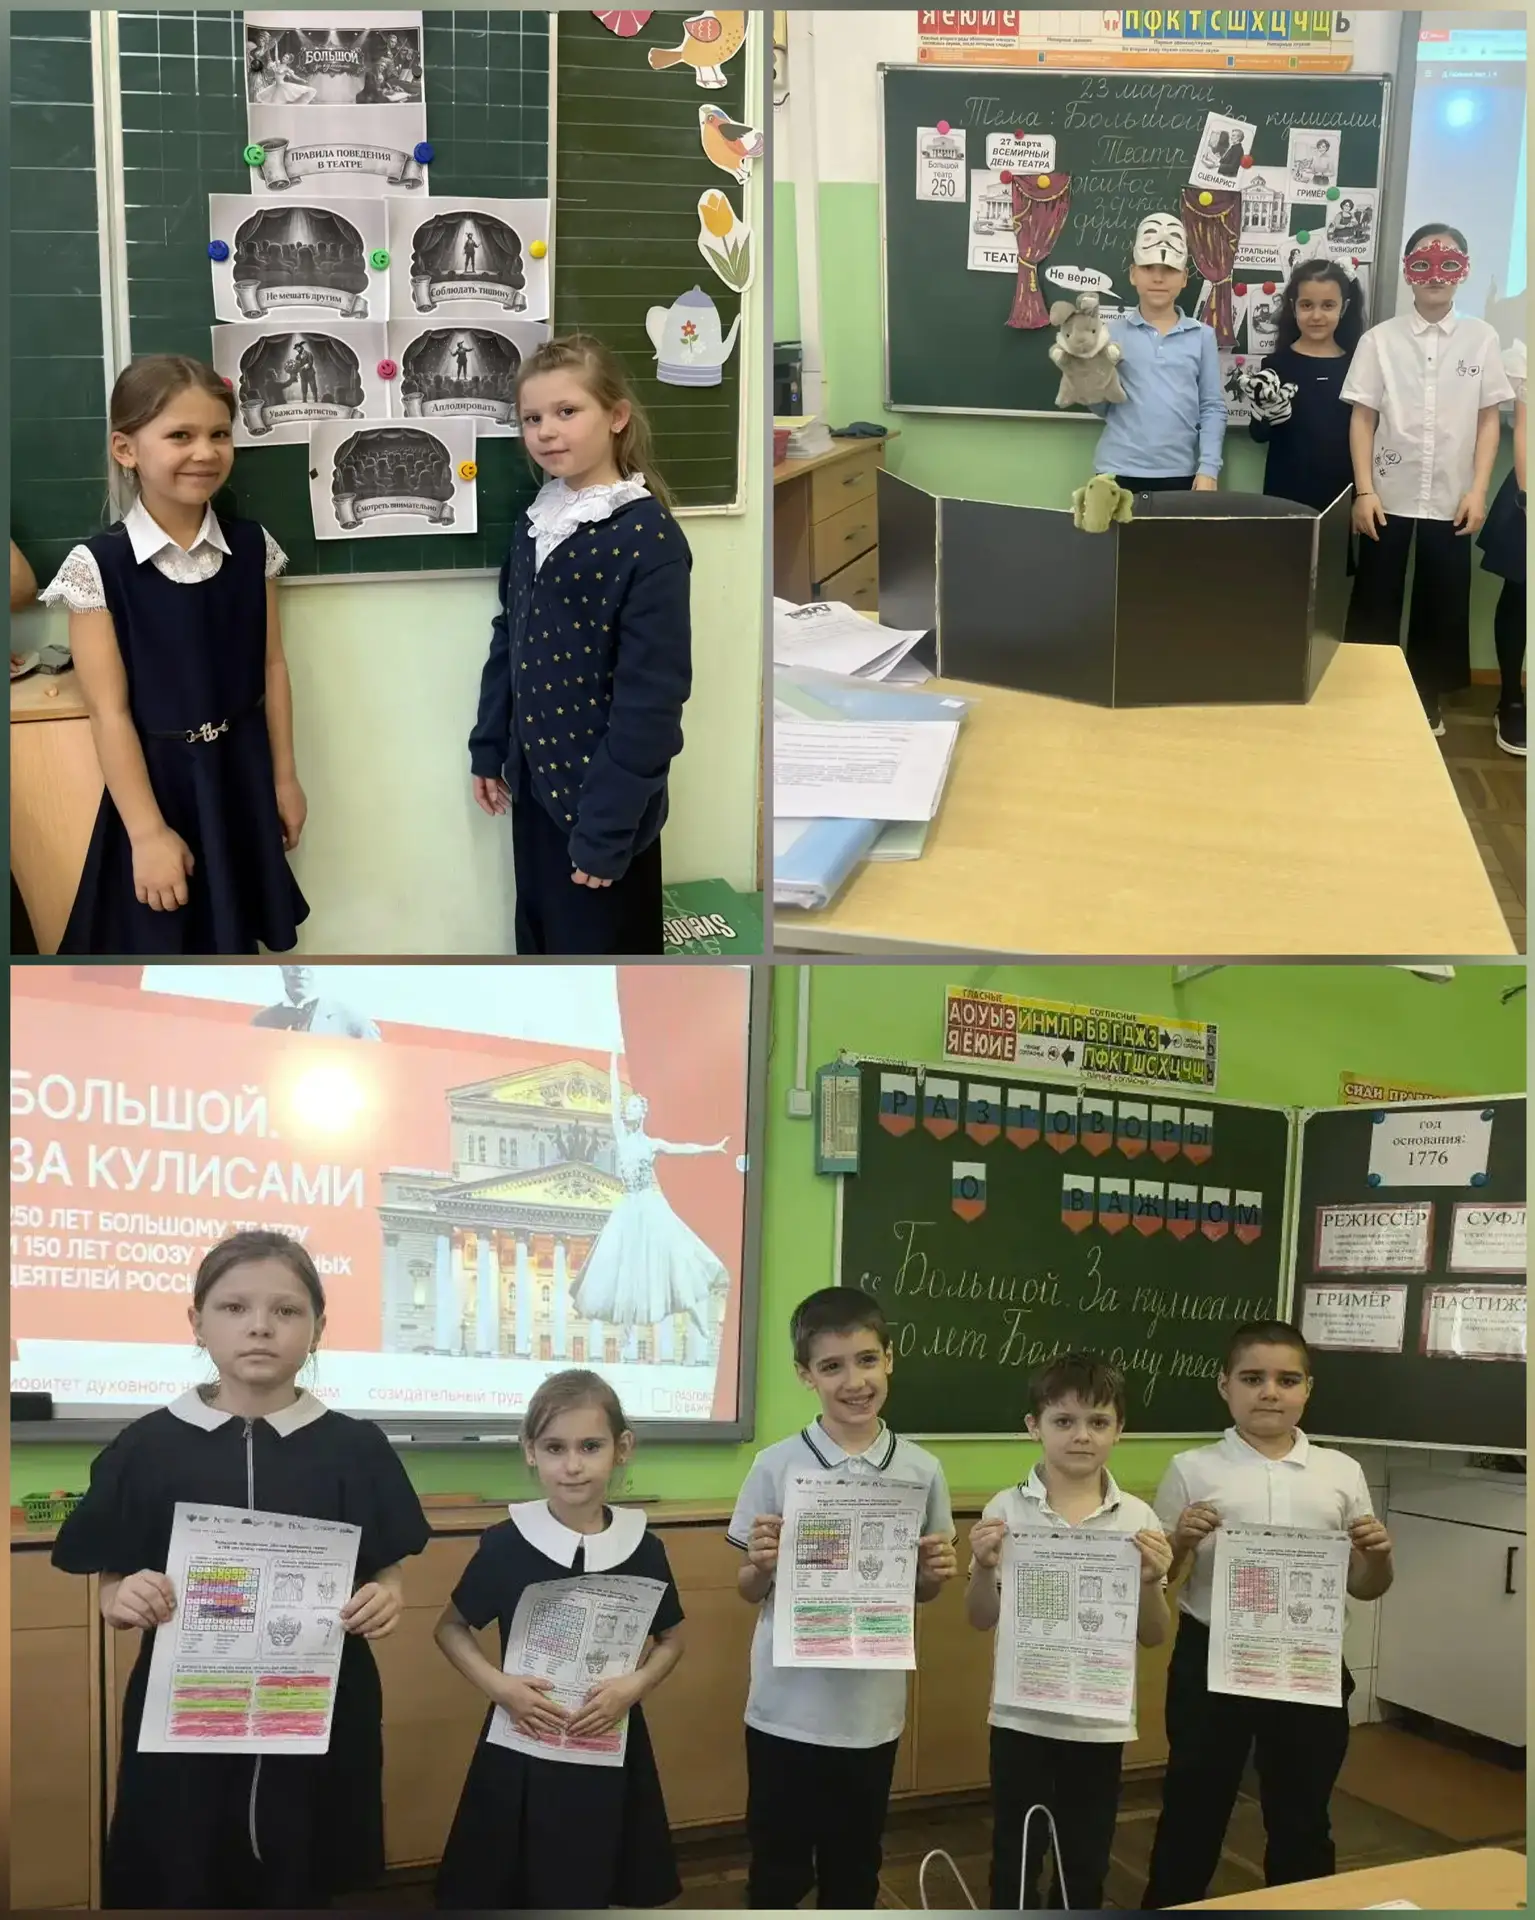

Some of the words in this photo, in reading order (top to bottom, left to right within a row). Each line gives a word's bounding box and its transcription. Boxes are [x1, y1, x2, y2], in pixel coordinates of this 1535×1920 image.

[305, 50, 359, 64] БОЛЬШОЙ
[1080, 77, 1110, 99] 23
[1000, 138, 1012, 146] 27
[1014, 140, 1042, 148] марта
[291, 151, 334, 163] ПРАВИЛА
[336, 150, 391, 162] ПОВЕДЕНИЯ
[992, 148, 1050, 158] ВСЕМИРНЫЙ
[317, 161, 325, 169] В
[326, 160, 363, 169] ТЕАТРЕ
[928, 161, 959, 169] Большой
[990, 158, 1015, 167] ДЕНЬ
[1018, 159, 1050, 169] ТЕАТРА
[934, 171, 953, 179] театр
[1197, 171, 1236, 189] СЦЕНАРИСТ
[931, 178, 956, 197] 250
[1238, 247, 1279, 256] ТРАЛЬНЫ
[1329, 245, 1367, 254] ЕКВИЗИТОР
[984, 251, 1019, 264] ТЕАТ
[1049, 268, 1065, 280] Не
[1066, 273, 1101, 286] верю!
[266, 292, 278, 301] Не
[279, 292, 311, 302] мешать
[312, 293, 342, 304] другим
[430, 287, 477, 298] Соблюдать
[478, 287, 511, 300] тишину
[269, 408, 303, 419] Уважать
[303, 408, 338, 418] артистов
[431, 402, 497, 413] Аплодировать
[356, 502, 390, 513] Смотреть
[390, 501, 437, 512] внимательно
[963, 989, 1003, 1002] ГЛАСНЫЕ
[1089, 1008, 1137, 1021] СОГЛАСНЫЕ
[1344, 1083, 1383, 1100] СИДИ
[892, 1090, 1208, 1145] РАЗГОВОРЫ
[1419, 1120, 1442, 1130] год
[1393, 1133, 1466, 1146] основания:
[1408, 1150, 1449, 1166] 1776
[11, 1137, 73, 1187] ЗА
[88, 1144, 364, 1208] КУЛИСАМИ
[1070, 1188, 1258, 1225] ВАЖНОМ
[49, 1208, 93, 1231] ЛЕТ
[99, 1212, 226, 1238] БОЛЬШОМУ
[1323, 1208, 1427, 1228] РЕЖИССЁР
[24, 1236, 61, 1258] 150
[66, 1239, 113, 1261] ЛЕТ
[115, 1242, 196, 1266] СОЮЗУ
[1079, 1245, 1121, 1312] За
[1315, 1291, 1391, 1308] ГРИМЁР
[924, 1327, 989, 1359] лет
[86, 1379, 176, 1395] духовного
[368, 1387, 486, 1403] созидательный
[490, 1389, 524, 1406] труд
